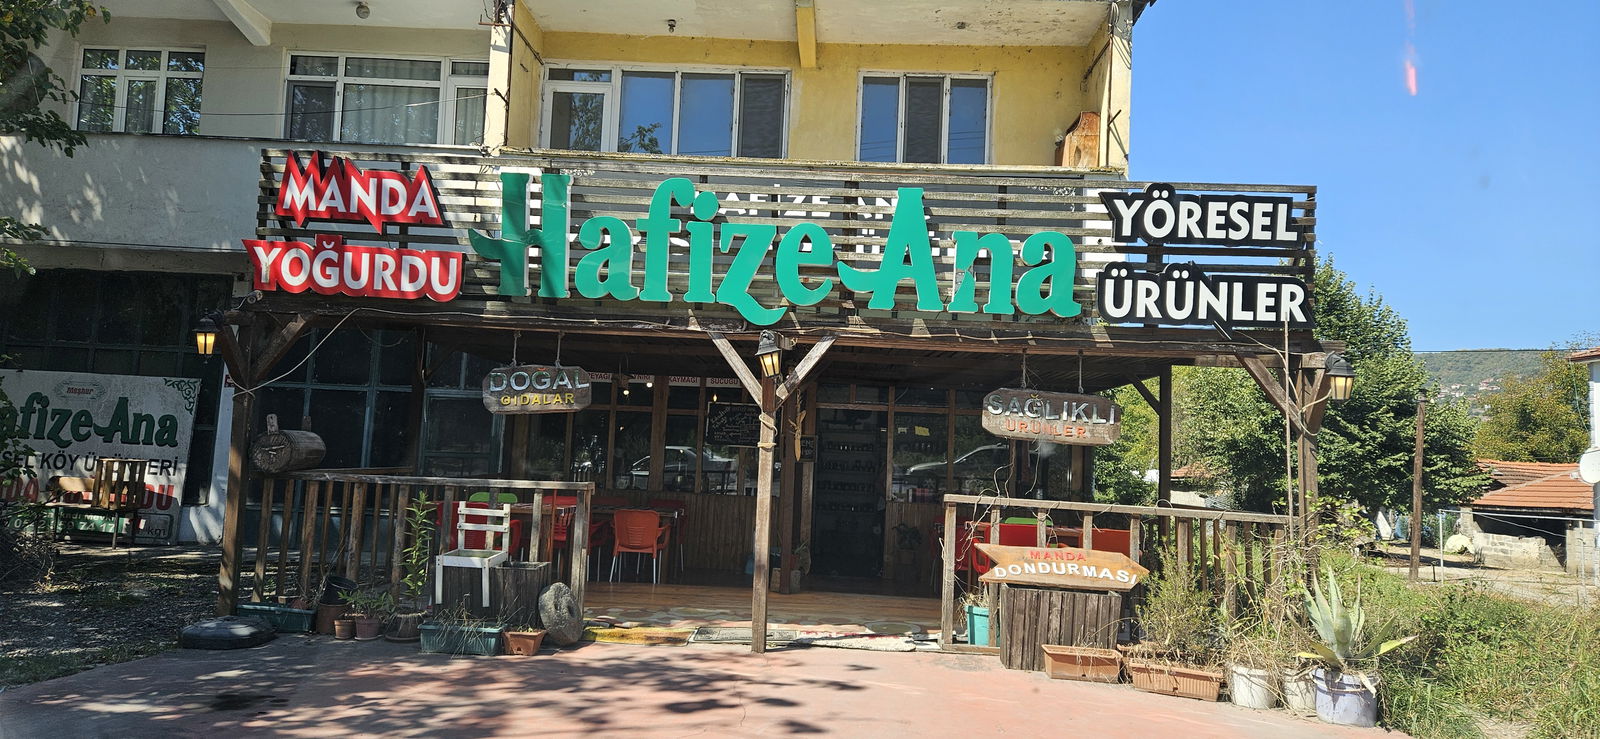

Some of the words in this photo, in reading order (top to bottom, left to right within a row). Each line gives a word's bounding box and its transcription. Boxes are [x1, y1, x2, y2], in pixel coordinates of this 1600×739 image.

[282, 172, 438, 219] MANDA
[690, 184, 831, 217] AFİZE
[1113, 189, 1298, 241] YÖRESEL
[468, 172, 833, 325] Hafize
[837, 187, 1082, 317] Ana
[252, 241, 458, 296] YOĞURDU
[1104, 268, 1307, 323] ÜRÜNLER
[489, 367, 590, 392] DOĞAL
[500, 393, 575, 406] GIDALAR
[987, 394, 1115, 425] SAĞLIKLI
[94, 396, 179, 448] Ana
[40, 451, 80, 471] KÖY
[1029, 550, 1087, 562] MANDA
[994, 561, 1138, 585] DONDURMASI
